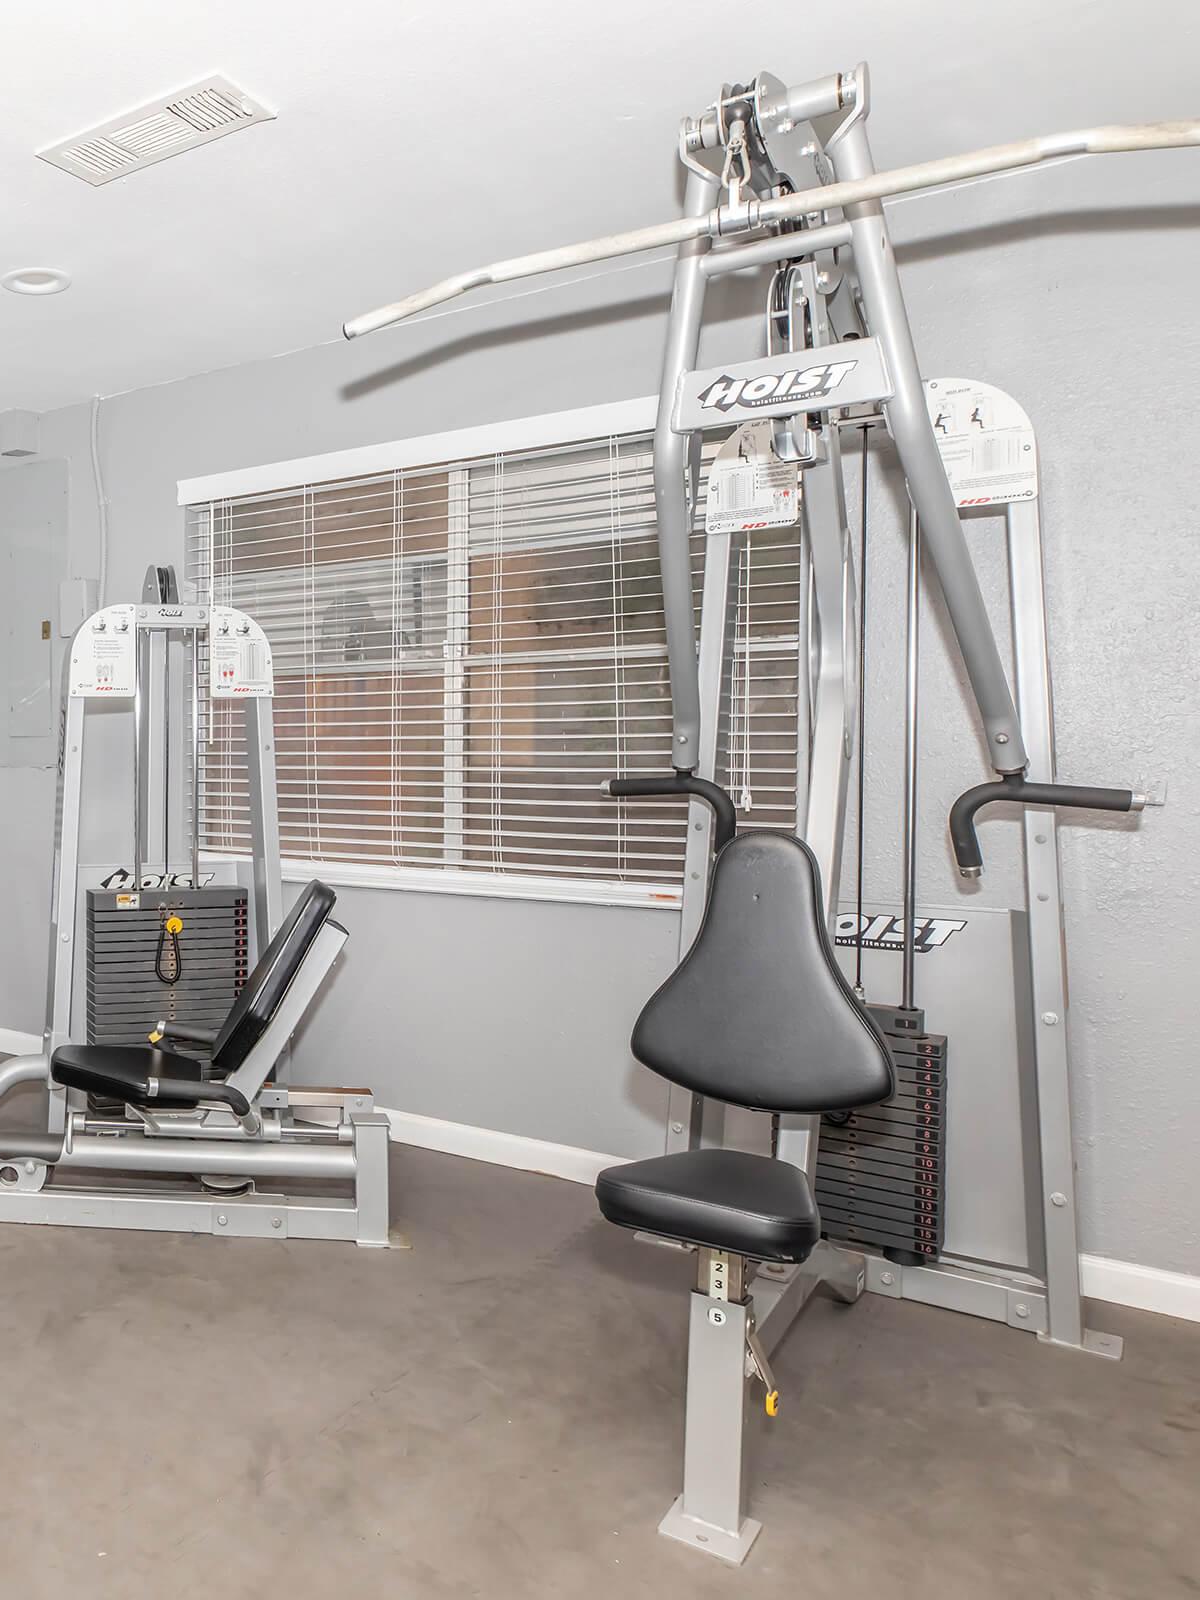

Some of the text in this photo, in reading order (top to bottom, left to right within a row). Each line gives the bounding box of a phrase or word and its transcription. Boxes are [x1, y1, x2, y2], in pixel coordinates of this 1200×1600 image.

[700, 360, 859, 409] HOIST
[751, 391, 823, 407] hoistfitness.com
[835, 913, 968, 946] OIST
[904, 1019, 909, 1028] 1
[925, 1045, 933, 1054] 2
[924, 1059, 932, 1068] 3
[923, 1073, 931, 1082] 4
[925, 1087, 933, 1096] 5
[923, 1102, 931, 1111] 6
[924, 1116, 932, 1125] 7
[923, 1130, 931, 1139] 8
[922, 1144, 930, 1153] 9
[921, 1158, 932, 1168] 10
[921, 1172, 932, 1182] 11
[921, 1187, 932, 1197] 12
[921, 1201, 932, 1211] 13
[921, 1215, 932, 1225] 14
[921, 1230, 932, 1240] 15
[921, 1244, 932, 1254] 16
[715, 1263, 723, 1272] 2
[714, 1280, 723, 1289] 3
[714, 1314, 722, 1322] 5
